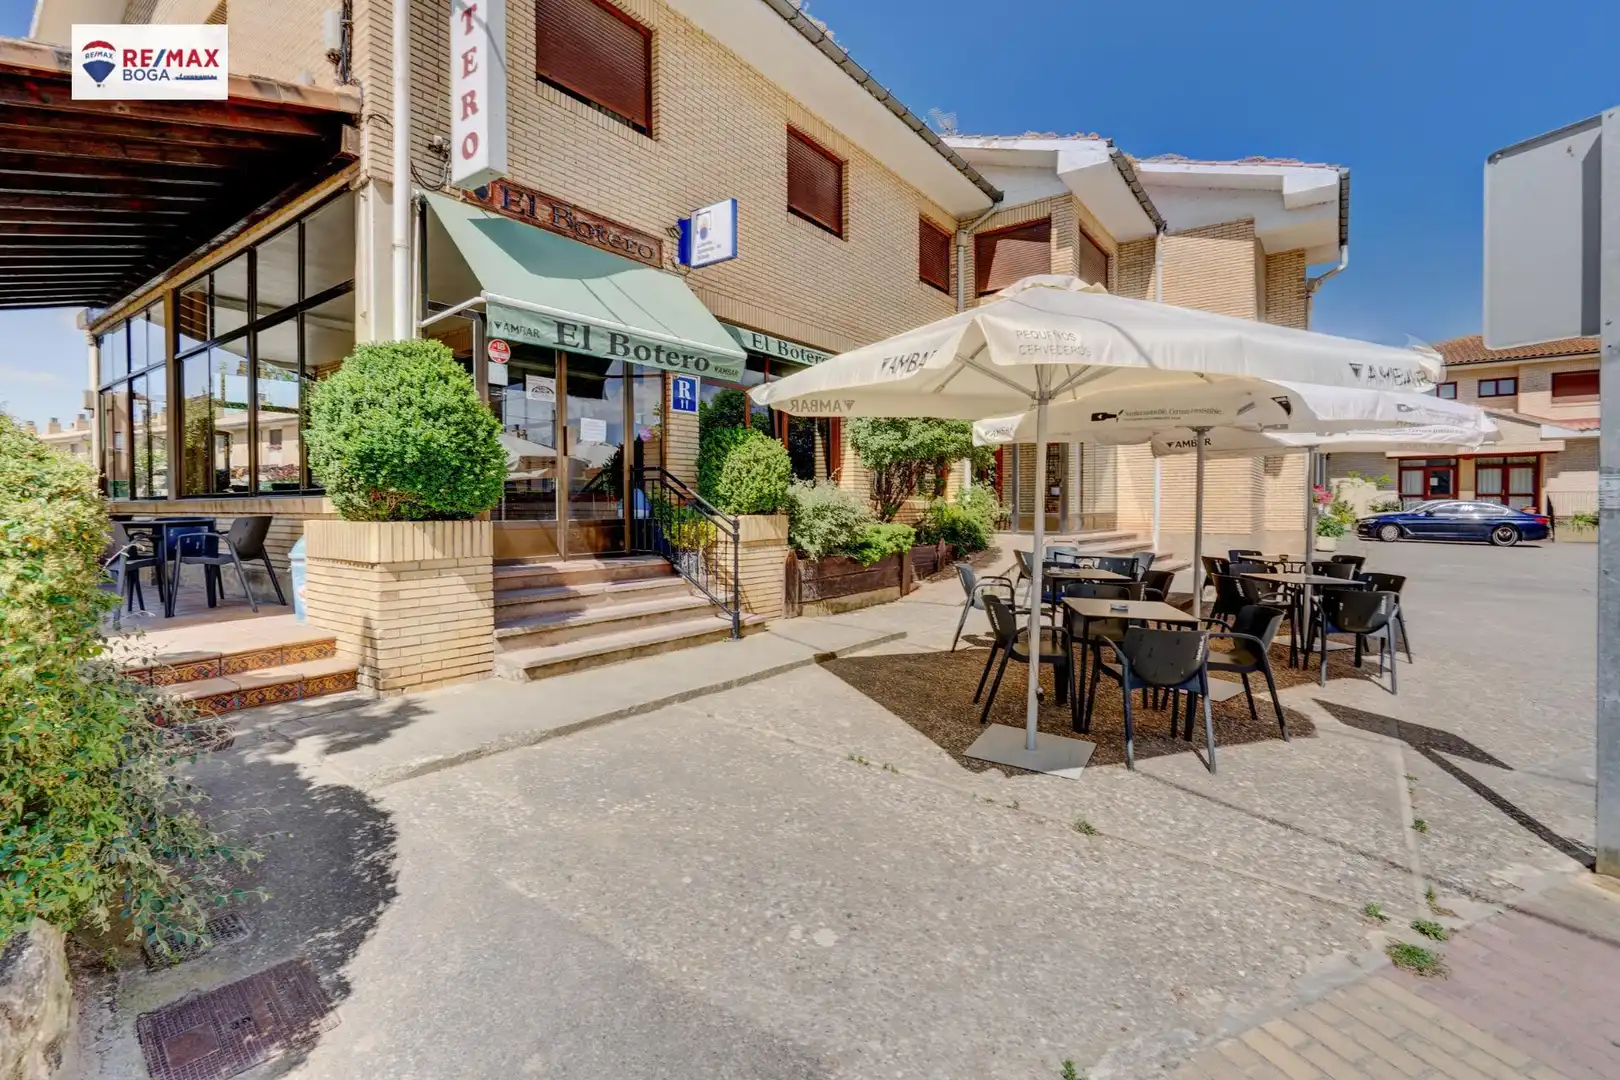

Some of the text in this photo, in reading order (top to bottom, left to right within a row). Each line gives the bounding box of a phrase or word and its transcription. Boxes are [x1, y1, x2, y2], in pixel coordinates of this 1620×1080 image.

[502, 185, 540, 219] El
[551, 205, 656, 260] Botero
[552, 320, 711, 373] El Botero
[751, 332, 770, 352] El
[1174, 438, 1212, 448] AMBR
